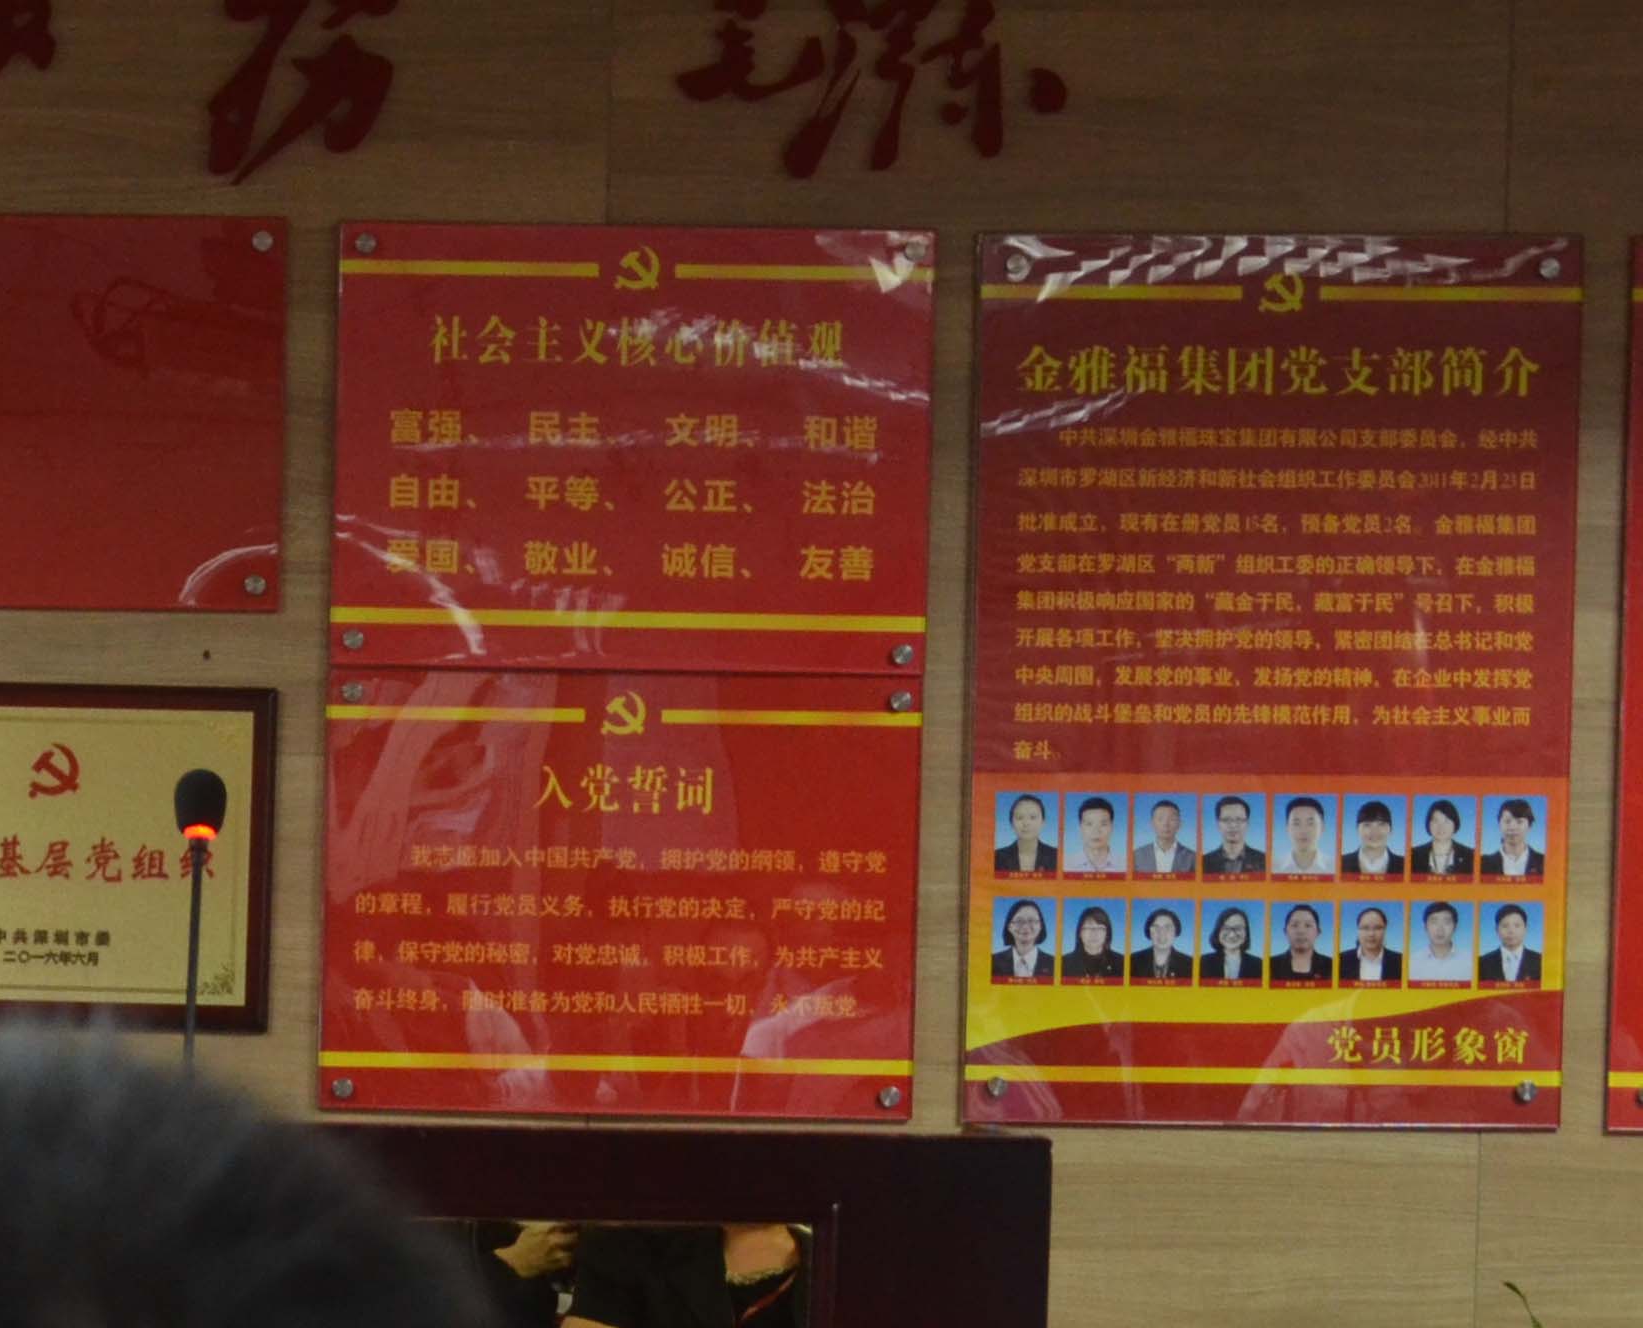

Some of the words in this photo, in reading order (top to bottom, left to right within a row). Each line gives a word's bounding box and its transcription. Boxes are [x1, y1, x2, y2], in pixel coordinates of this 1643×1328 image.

[430, 314, 845, 368] 社会主义核心价值观
[1016, 344, 1542, 398] 金雅福集团党支部简介
[804, 415, 879, 451] 和谐
[801, 481, 876, 516] 法治
[799, 544, 874, 581] 友善
[533, 763, 716, 816] 入党誓词
[1325, 1025, 1529, 1065] 党员形象窗
